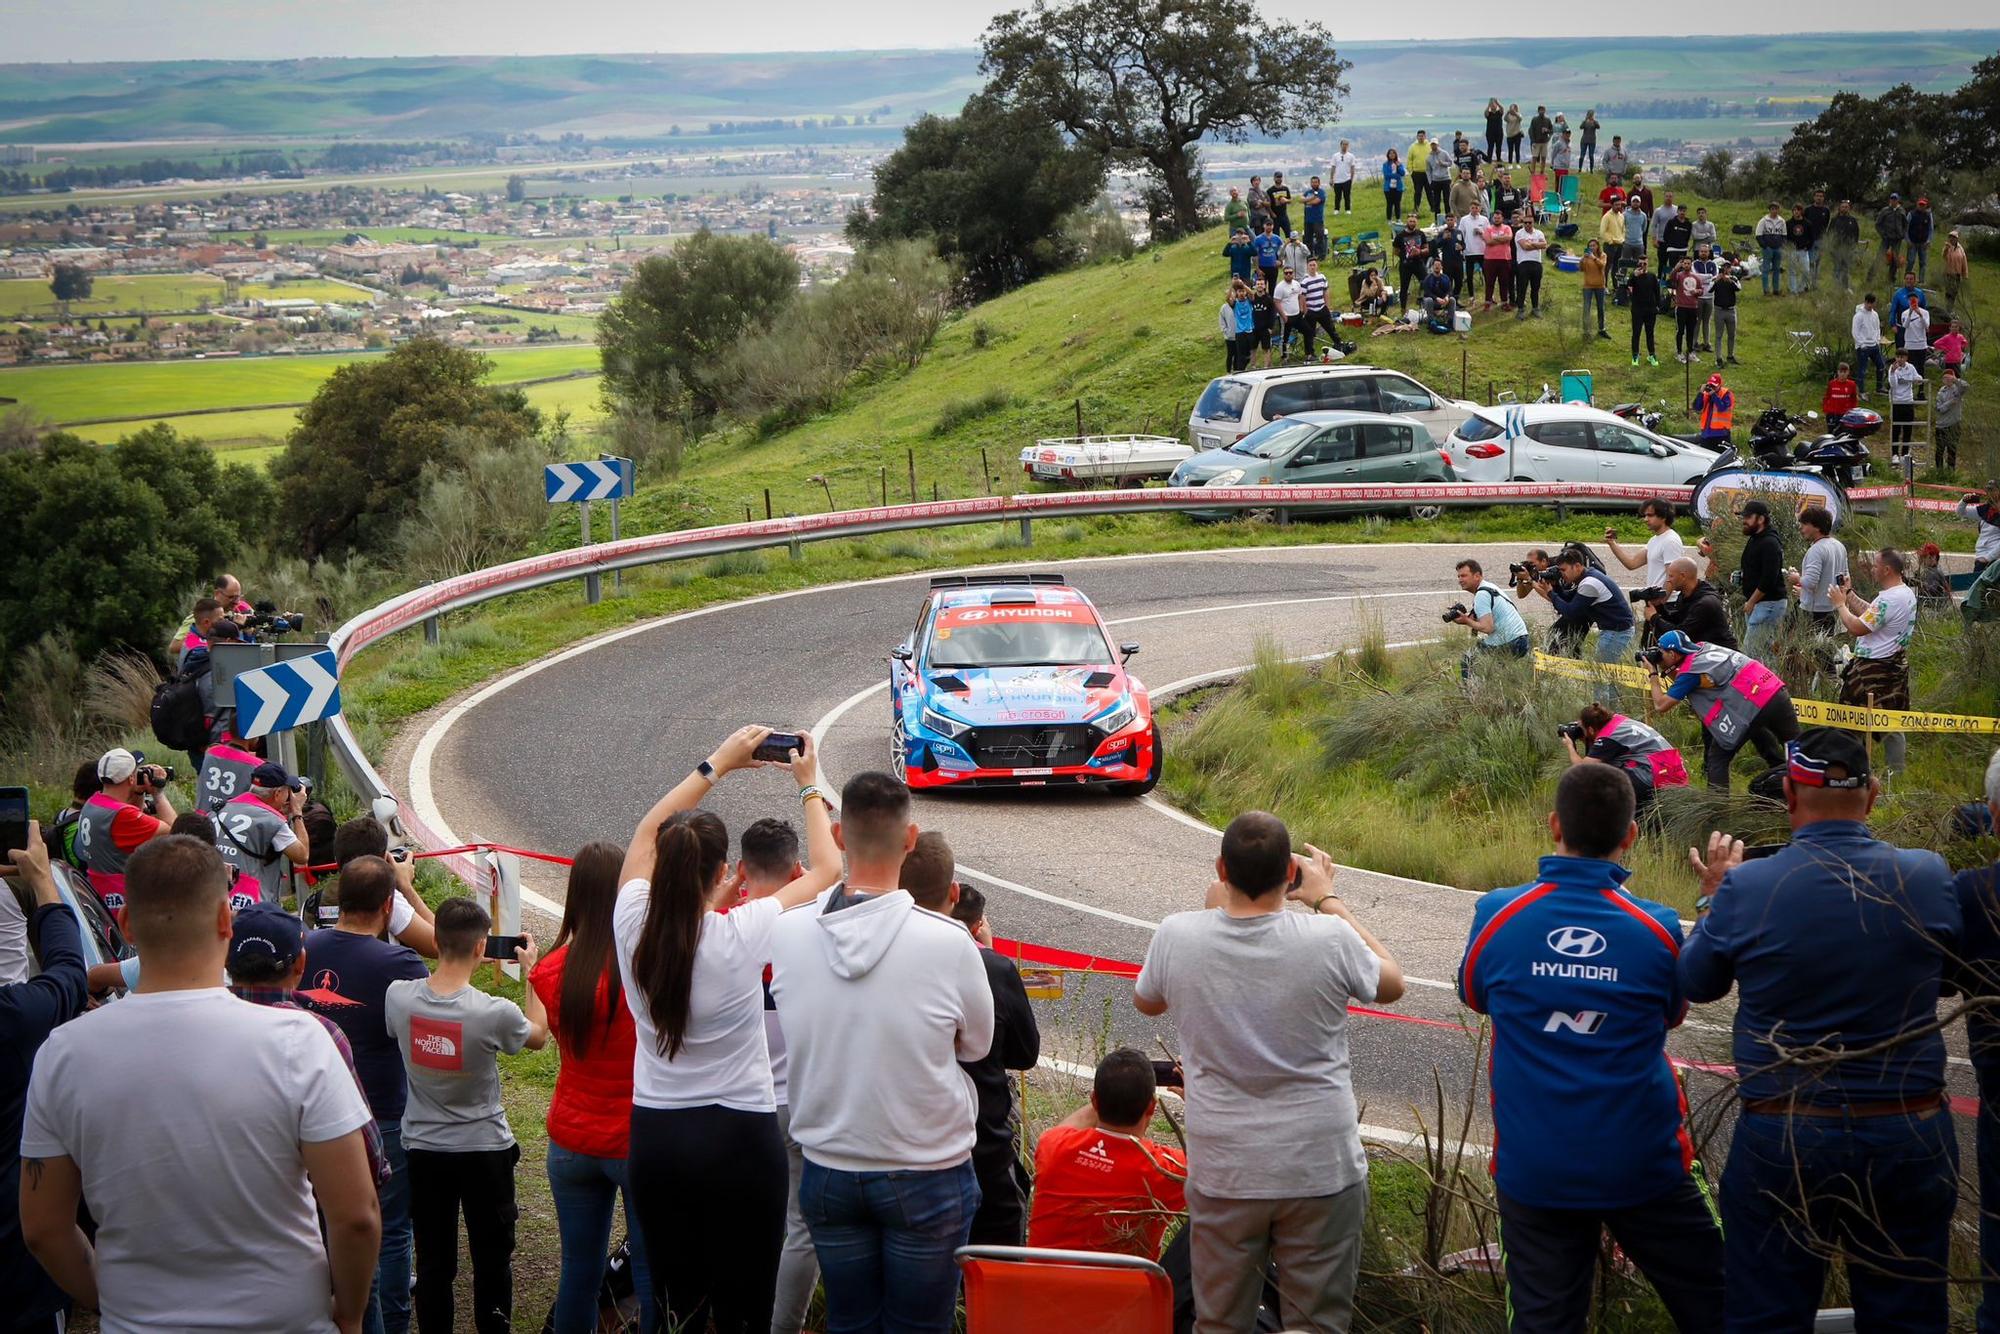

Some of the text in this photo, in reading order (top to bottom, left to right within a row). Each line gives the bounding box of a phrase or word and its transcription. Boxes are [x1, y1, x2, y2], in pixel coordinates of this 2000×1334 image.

[1364, 488, 1381, 498] PUBLICO
[1382, 488, 1394, 498] ZONA
[1394, 488, 1416, 498] PROHIBIDO
[1416, 488, 1434, 497] PUBLICO
[1434, 487, 1446, 497] ZONA
[1446, 487, 1468, 497] PROHIBIDO
[1468, 487, 1486, 496] PUBLICO
[1486, 487, 1498, 496] ZONA
[1498, 486, 1520, 496] PROHIBIDO
[1520, 486, 1538, 495] PUBLICO
[993, 608, 1073, 618] HYUNDAI
[1826, 707, 1848, 724] ZONA
[1901, 714, 1929, 727] ZONA
[206, 767, 236, 795] 33
[216, 844, 238, 856] OTO
[1532, 962, 1618, 982] HYUNDAI
[414, 1038, 442, 1050] NORTH
[422, 1045, 442, 1055] FACE
